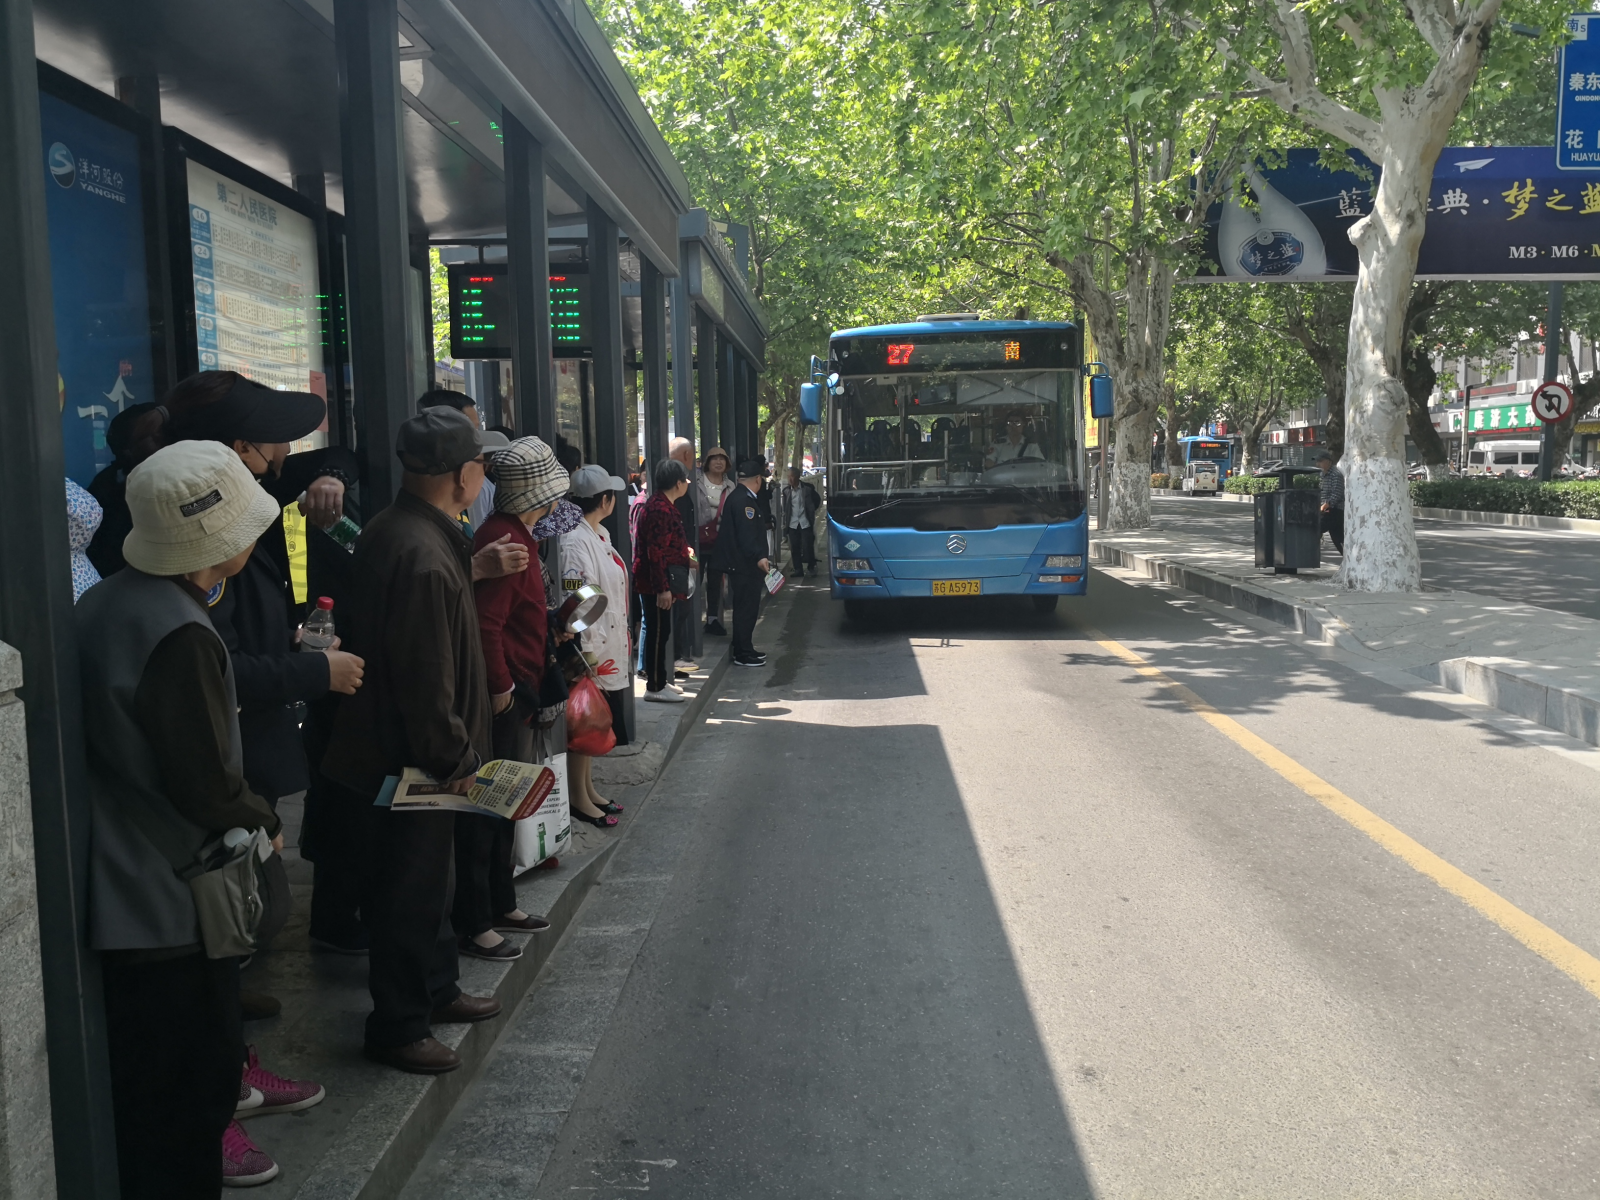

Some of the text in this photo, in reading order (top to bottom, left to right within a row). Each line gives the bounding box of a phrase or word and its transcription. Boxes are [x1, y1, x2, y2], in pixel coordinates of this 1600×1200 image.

[1567, 18, 1579, 32] 南
[1568, 72, 1600, 91] 秦东
[1571, 153, 1600, 161] HUAYU
[79, 158, 124, 190] 洋河股份
[80, 182, 126, 204] YANGHE
[216, 181, 278, 226] 第二人民医院
[196, 210, 205, 220] 16
[197, 246, 207, 257] 24
[887, 341, 1020, 365] 27 南
